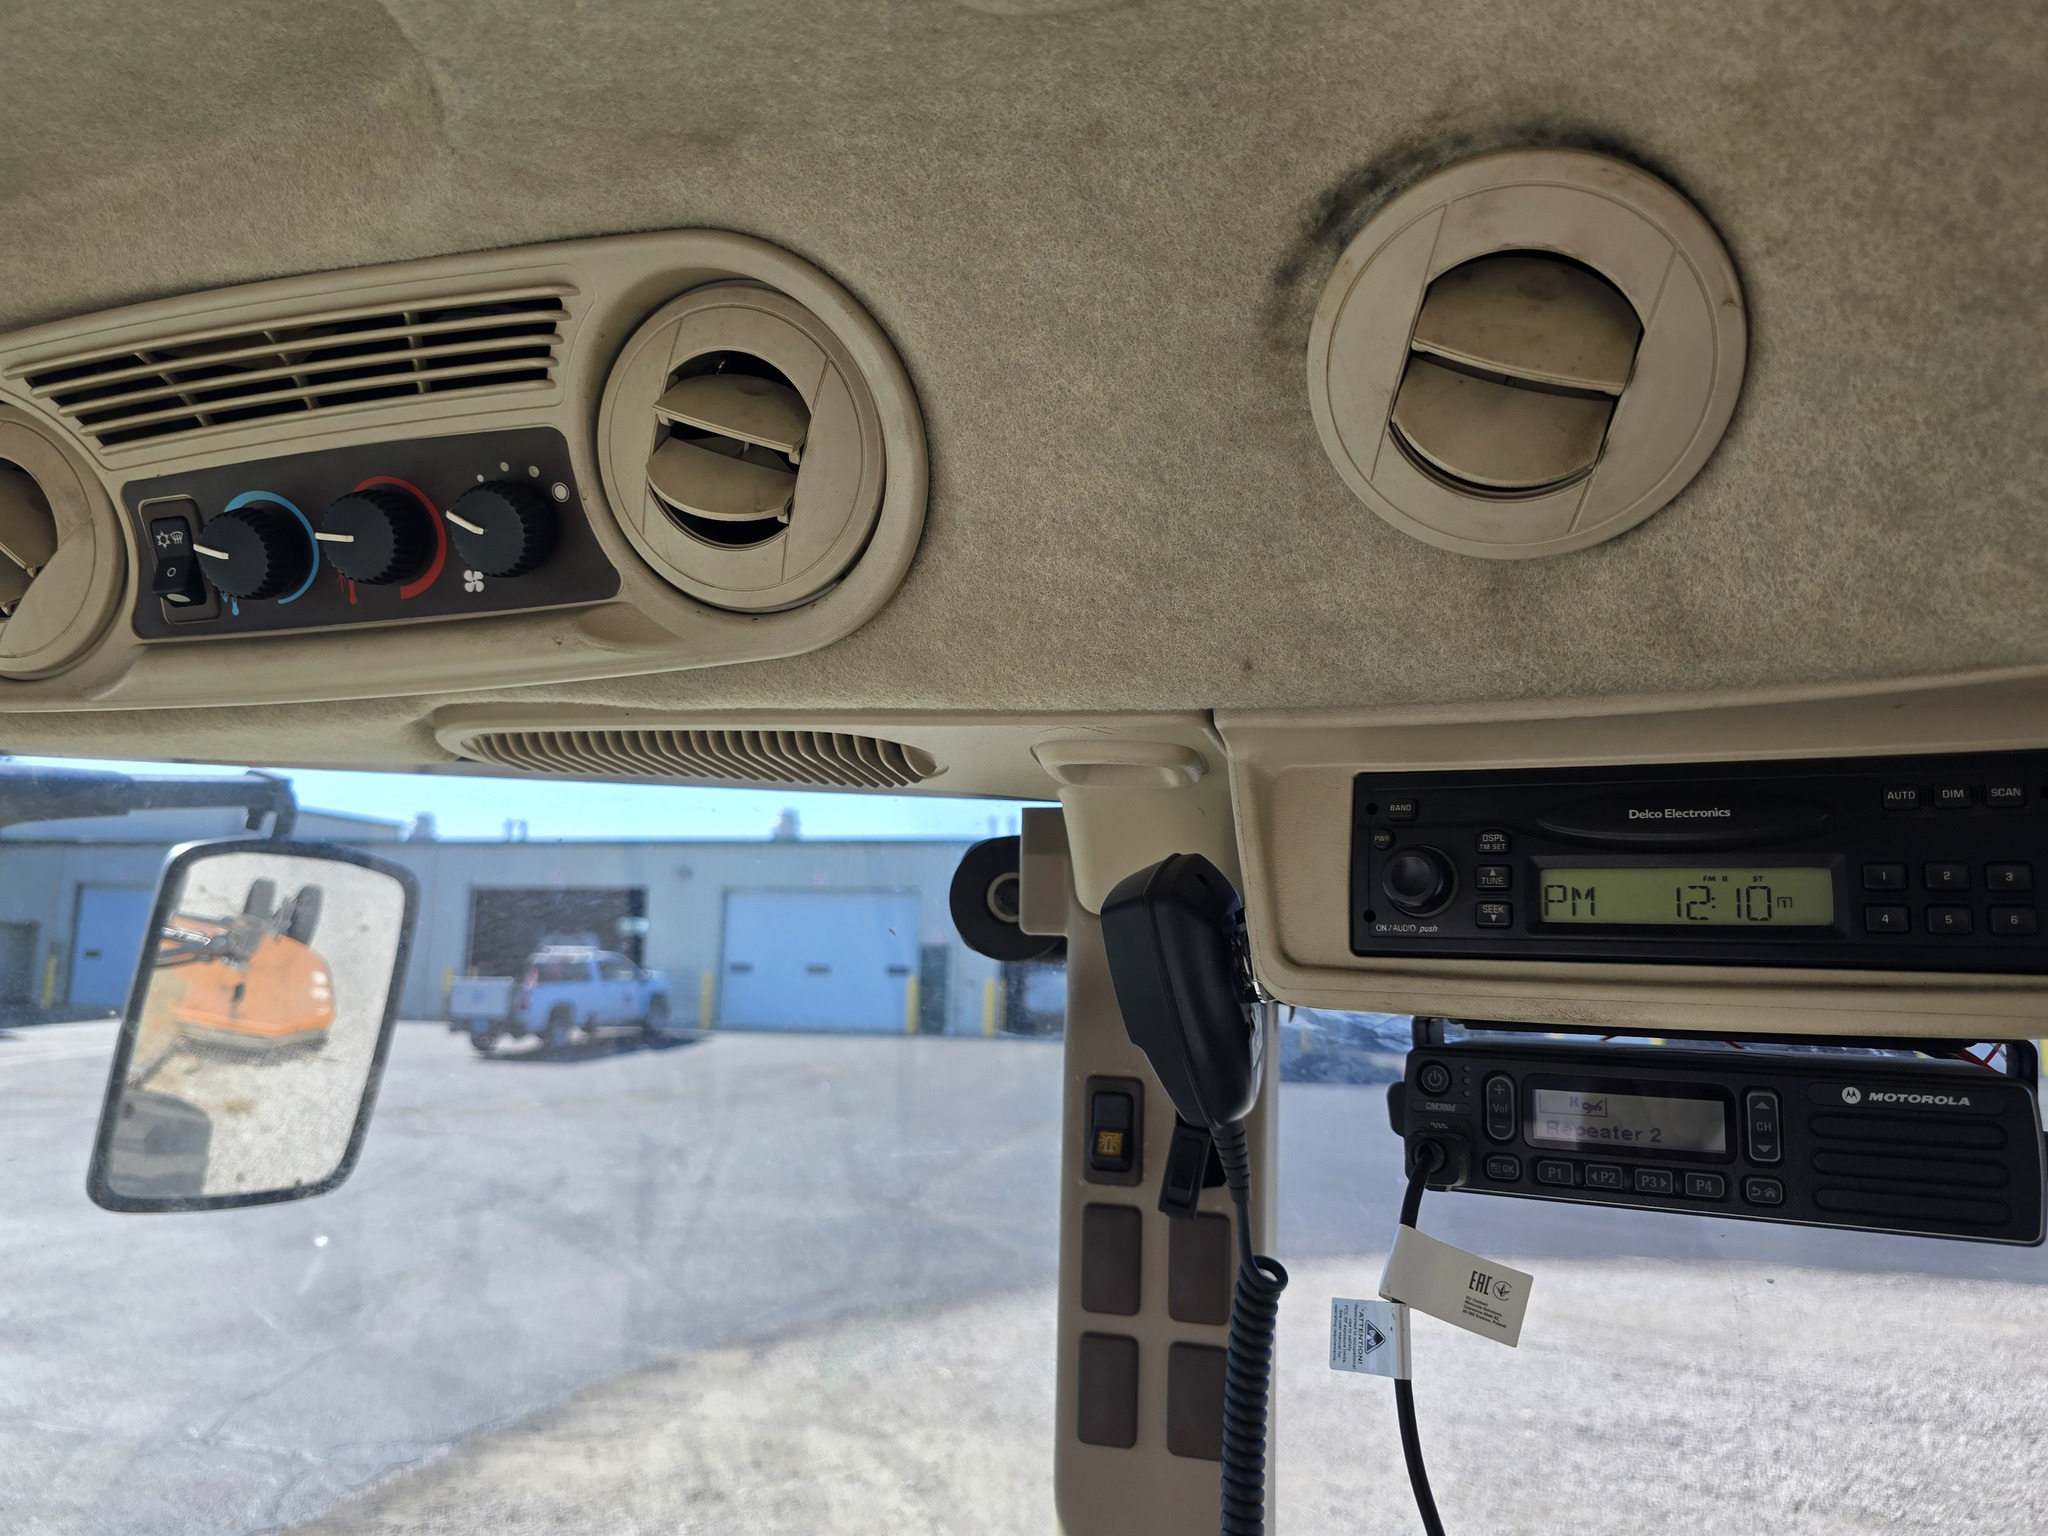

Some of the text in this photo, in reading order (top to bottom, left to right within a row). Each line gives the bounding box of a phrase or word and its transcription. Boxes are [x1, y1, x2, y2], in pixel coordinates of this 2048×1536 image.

[1887, 790, 1915, 800] AUTO
[1942, 789, 1963, 799] DIM
[1990, 788, 2021, 798] SCAN
[1389, 804, 1412, 812] BAND
[1629, 807, 1731, 820] Delco Electronics
[1482, 834, 1506, 842] DSPL
[1480, 877, 1504, 885] TUNE
[1752, 875, 1764, 883] ST
[1881, 872, 1886, 881] 1
[1943, 871, 1950, 881] 2
[2005, 872, 2013, 882] 3
[1543, 884, 1772, 922] PM 12:10
[1481, 905, 1505, 913] SEEK
[1881, 914, 1889, 924] 4
[1945, 915, 1952, 924] 5
[2010, 915, 2018, 925] 6
[1418, 925, 1439, 934] push
[1869, 1092, 1971, 1106] MOTOROLA
[1492, 1103, 1509, 1113] Vol
[1756, 1120, 1772, 1132] CH
[1546, 1120, 1662, 1143] Repeater 2
[1502, 1164, 1515, 1173] OK
[1548, 1166, 1562, 1180] P1
[1600, 1170, 1616, 1184] P2
[1641, 1174, 1658, 1188] P3
[1696, 1179, 1713, 1193] P4
[1469, 1270, 1492, 1295] EAC
